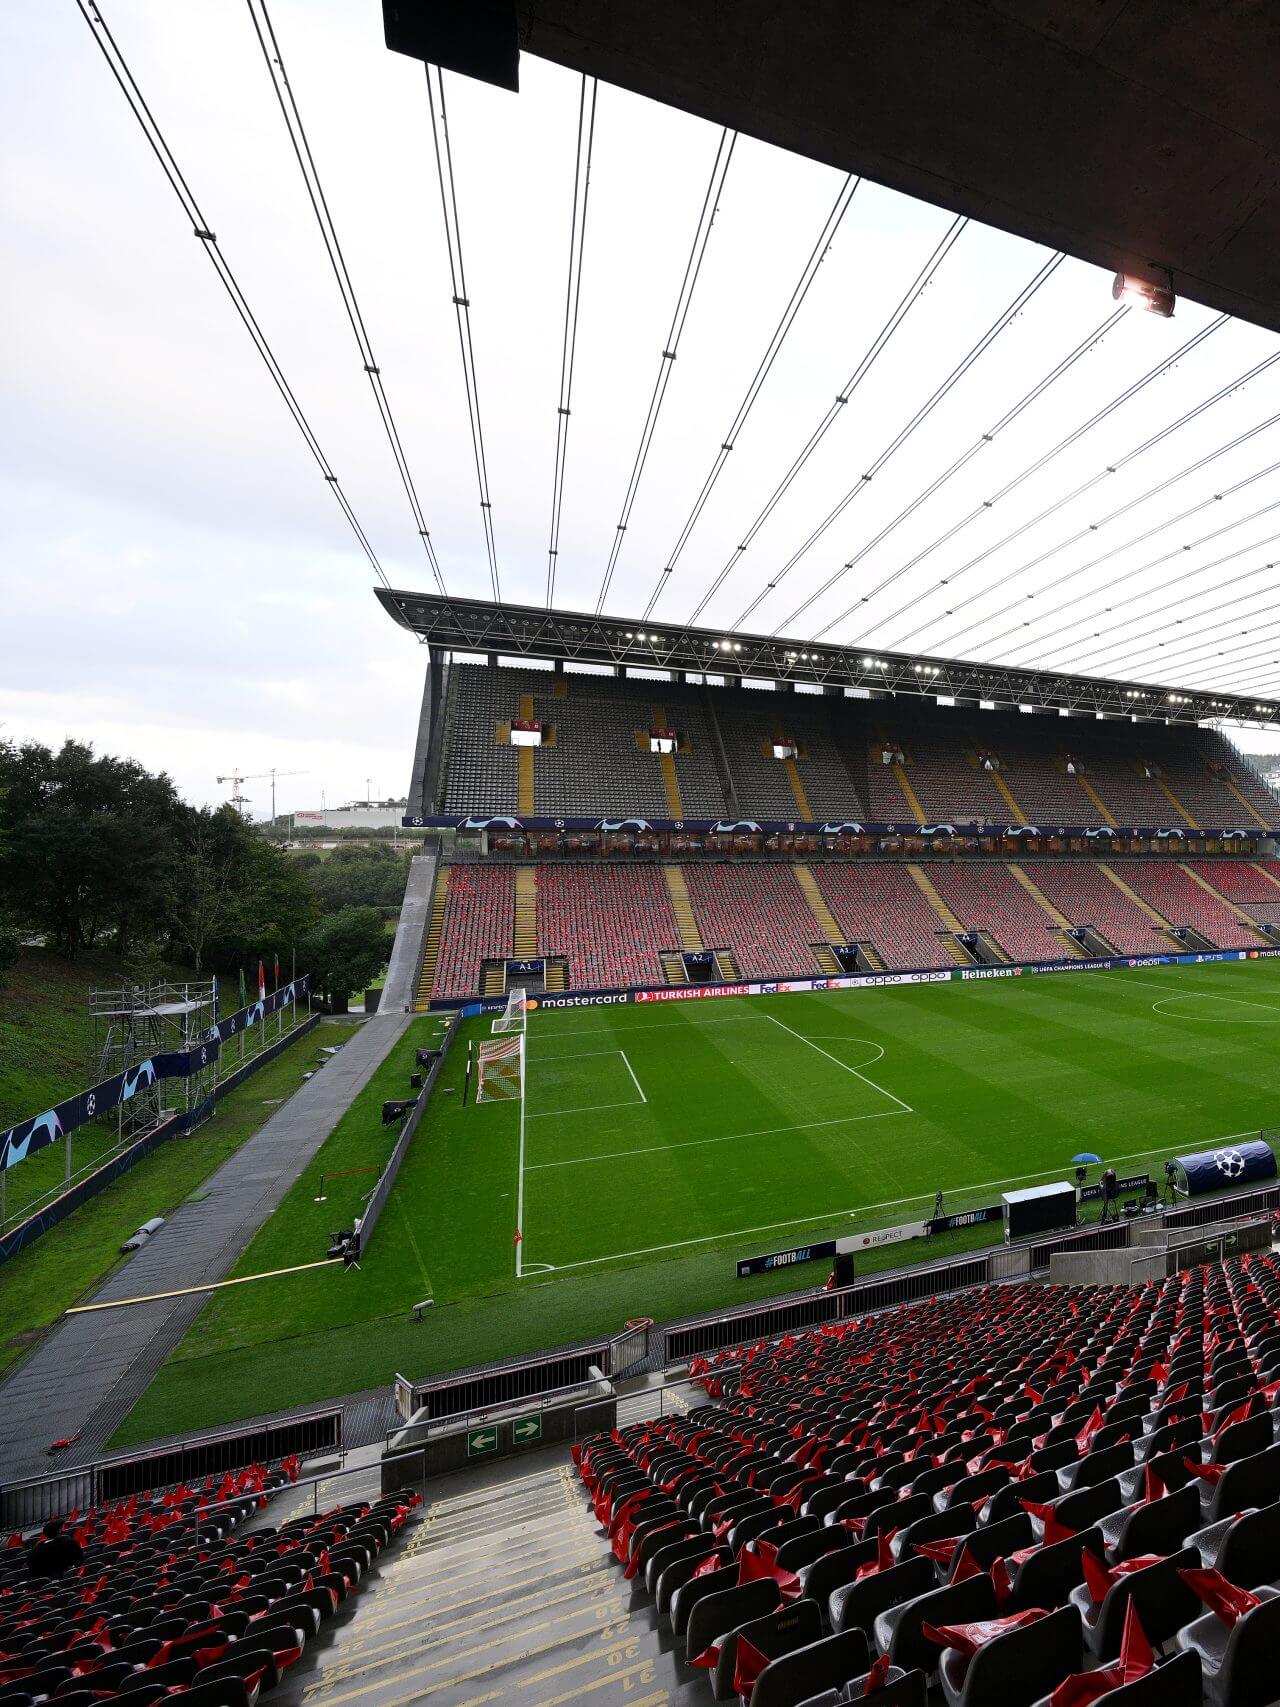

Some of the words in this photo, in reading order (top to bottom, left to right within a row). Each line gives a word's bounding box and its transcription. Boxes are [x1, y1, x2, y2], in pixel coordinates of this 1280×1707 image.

[1137, 957, 1160, 967] pepsi
[962, 968, 1013, 980] Heineken
[760, 983, 792, 993] FedEx
[811, 979, 841, 990] FedEx
[654, 989, 701, 1000] TURKISH
[703, 986, 749, 997] AIRLINES
[542, 993, 627, 1008] mastercard
[1128, 1178, 1147, 1187] LEAGUE
[948, 1211, 987, 1228] #FOOTBALL
[872, 1230, 903, 1243] RESPECT
[765, 1248, 811, 1268] #FOOTBALL
[607, 1645, 641, 1666] 30
[623, 1667, 657, 1692] 31
